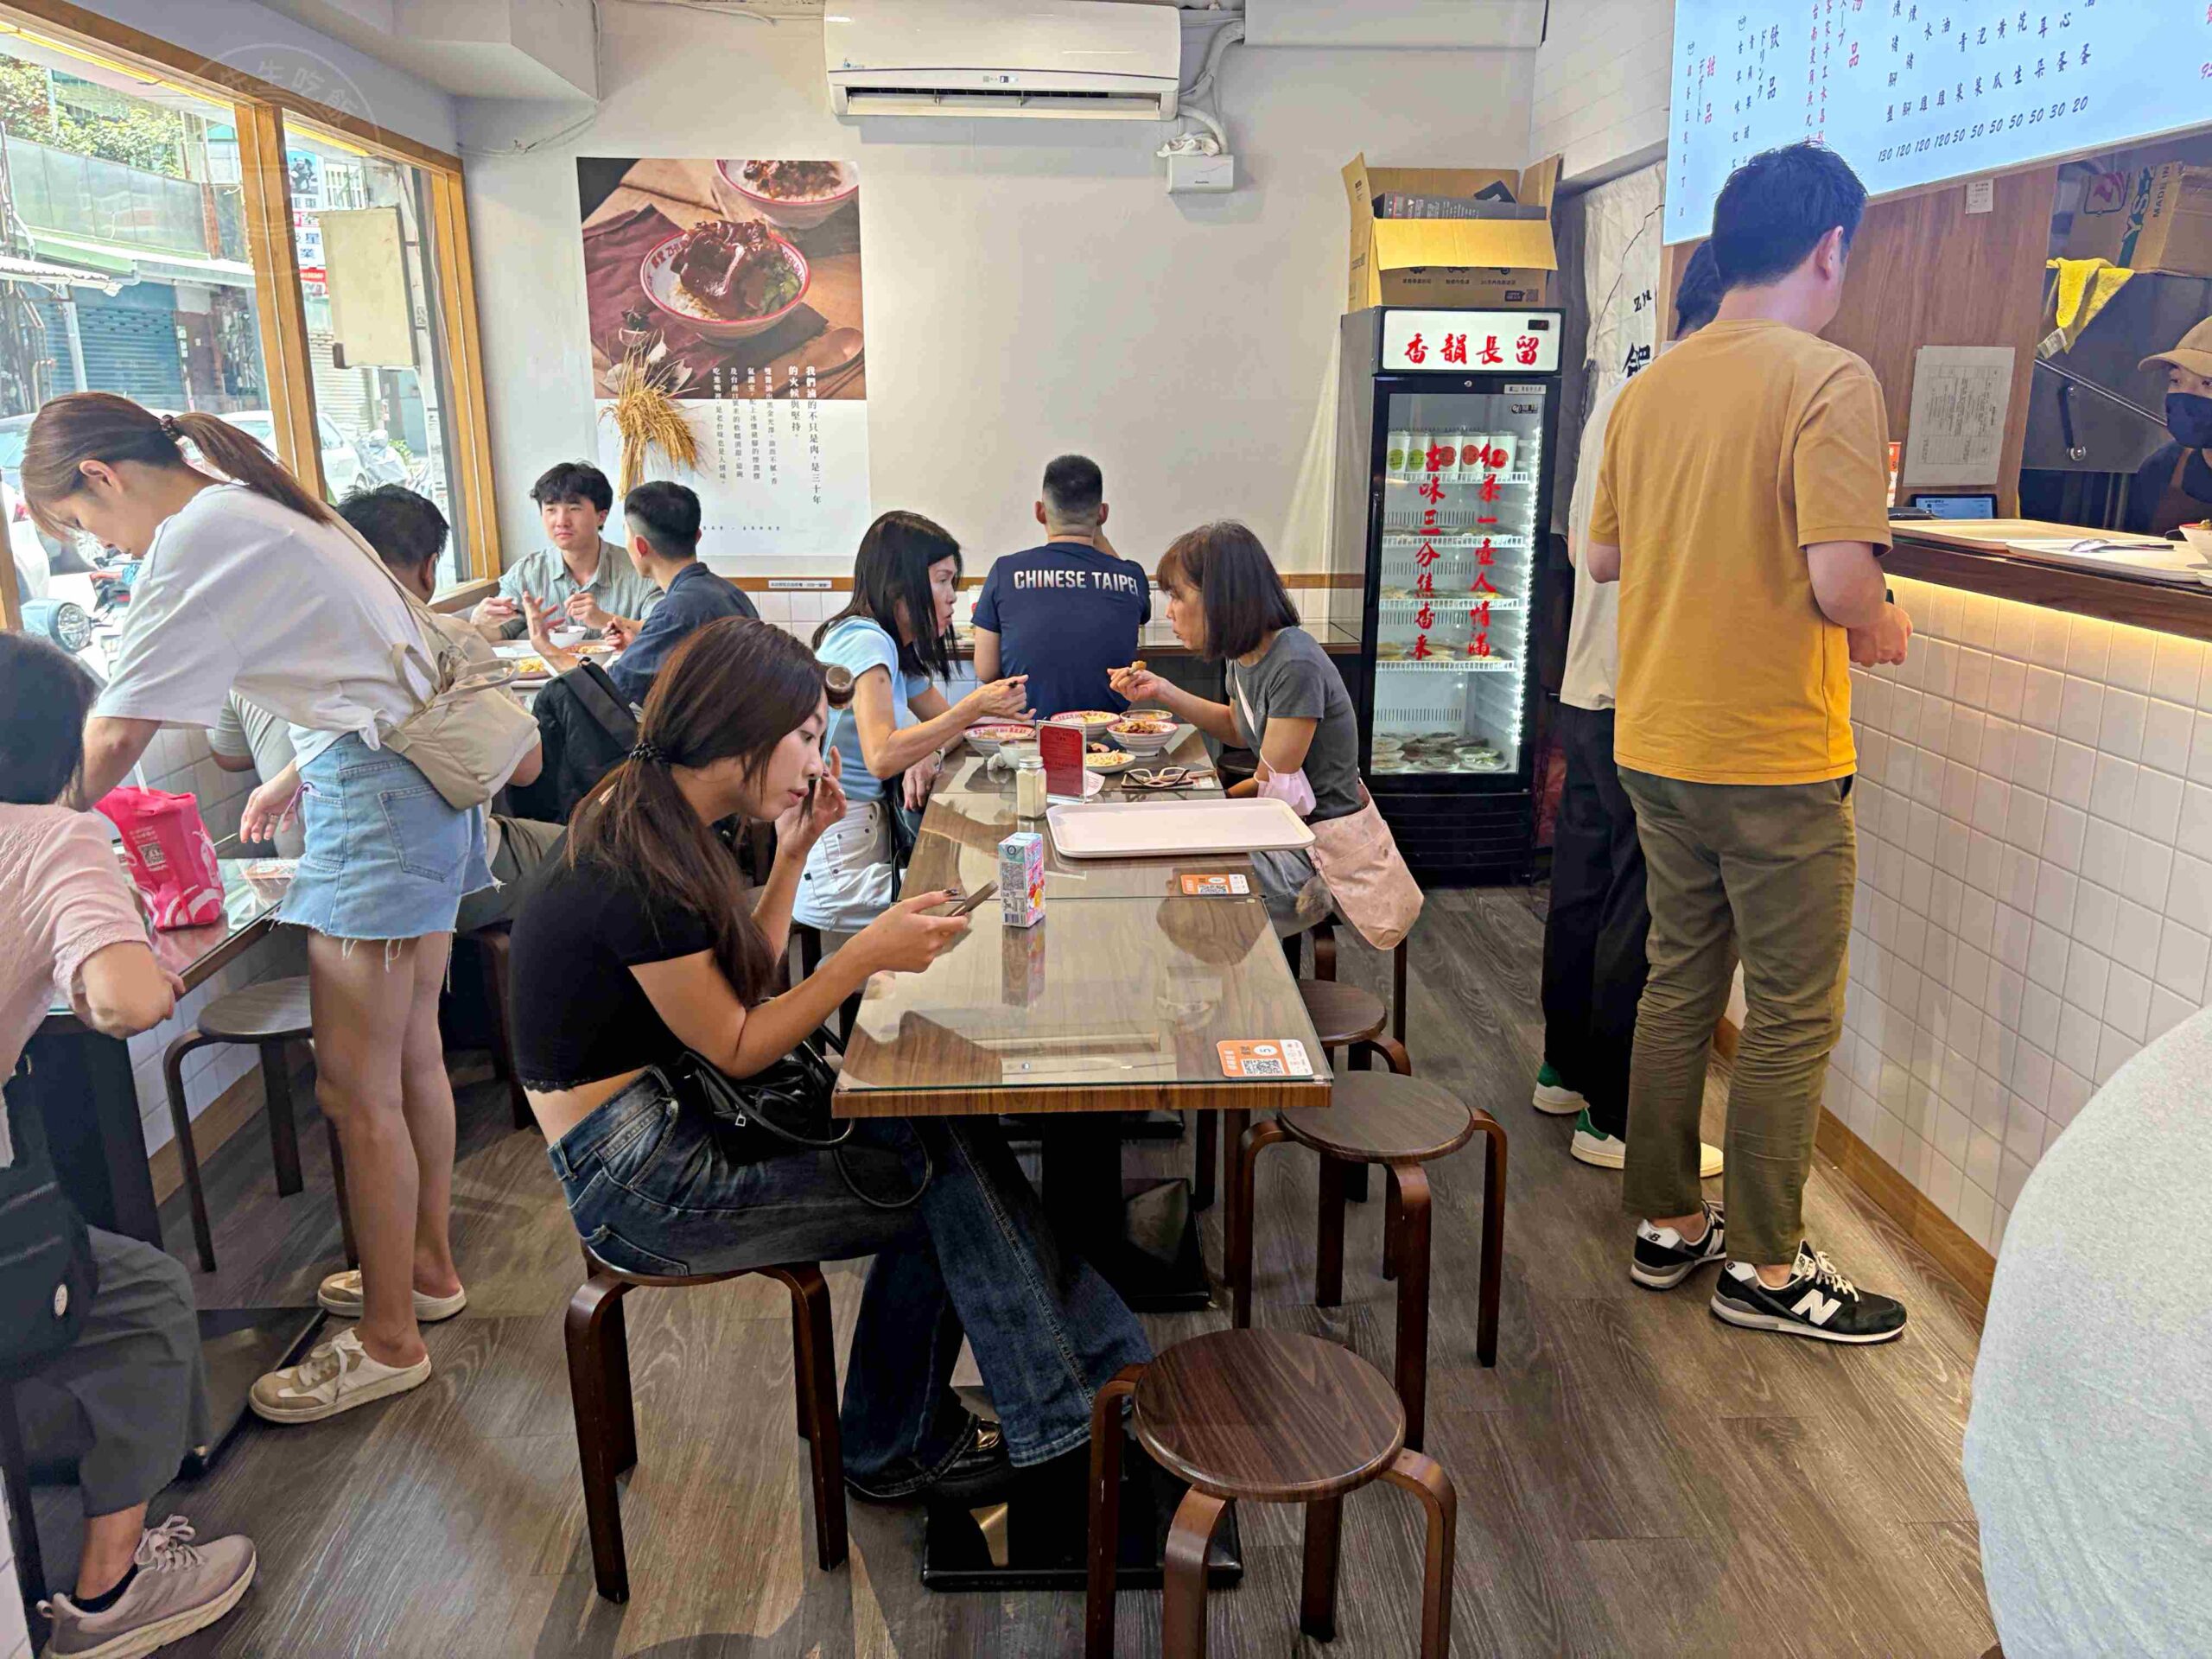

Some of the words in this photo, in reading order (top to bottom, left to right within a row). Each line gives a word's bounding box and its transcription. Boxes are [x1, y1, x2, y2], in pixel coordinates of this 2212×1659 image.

[2049, 102, 2066, 119] 30
[2072, 95, 2088, 113] 20
[2008, 113, 2024, 130] 50
[2029, 108, 2044, 124] 50
[1970, 123, 1984, 139] 50
[1989, 118, 2004, 134] 50
[1934, 133, 1950, 149] 120
[1952, 129, 1966, 143] 50
[1896, 143, 1911, 158] 120
[1915, 137, 1930, 152] 120
[1878, 148, 1893, 162] 130
[1404, 333, 1540, 365] 香韻長留
[1014, 569, 1087, 590] CHINESE
[1091, 571, 1139, 596] TAIPEI
[1790, 1288, 1841, 1325] N
